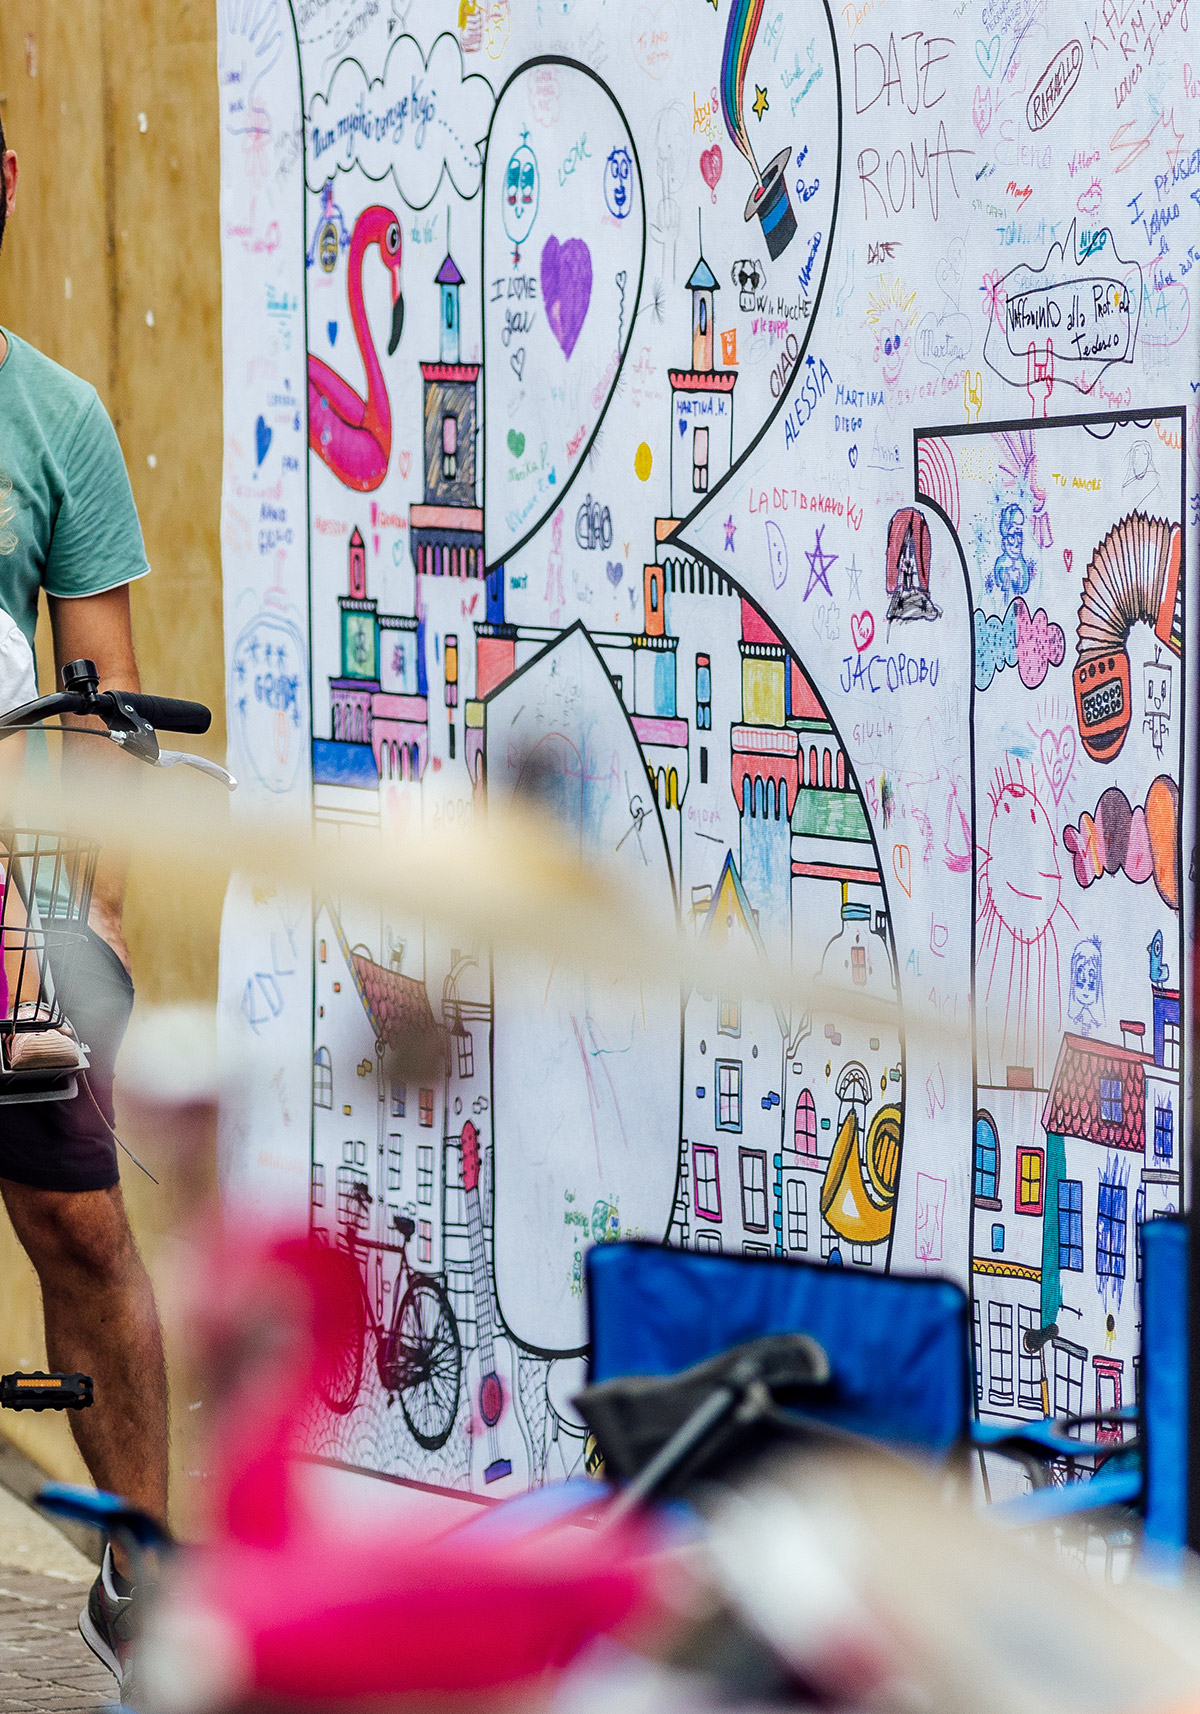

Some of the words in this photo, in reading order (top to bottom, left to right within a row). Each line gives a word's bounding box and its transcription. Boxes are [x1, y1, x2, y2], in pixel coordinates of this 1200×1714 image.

[853, 31, 956, 115] DAJE
[858, 120, 975, 222] ROMA
[770, 333, 799, 398] CIAO
[835, 384, 884, 408] MARTINA
[784, 358, 833, 450] ALESSIA
[835, 414, 863, 432] DIEGO
